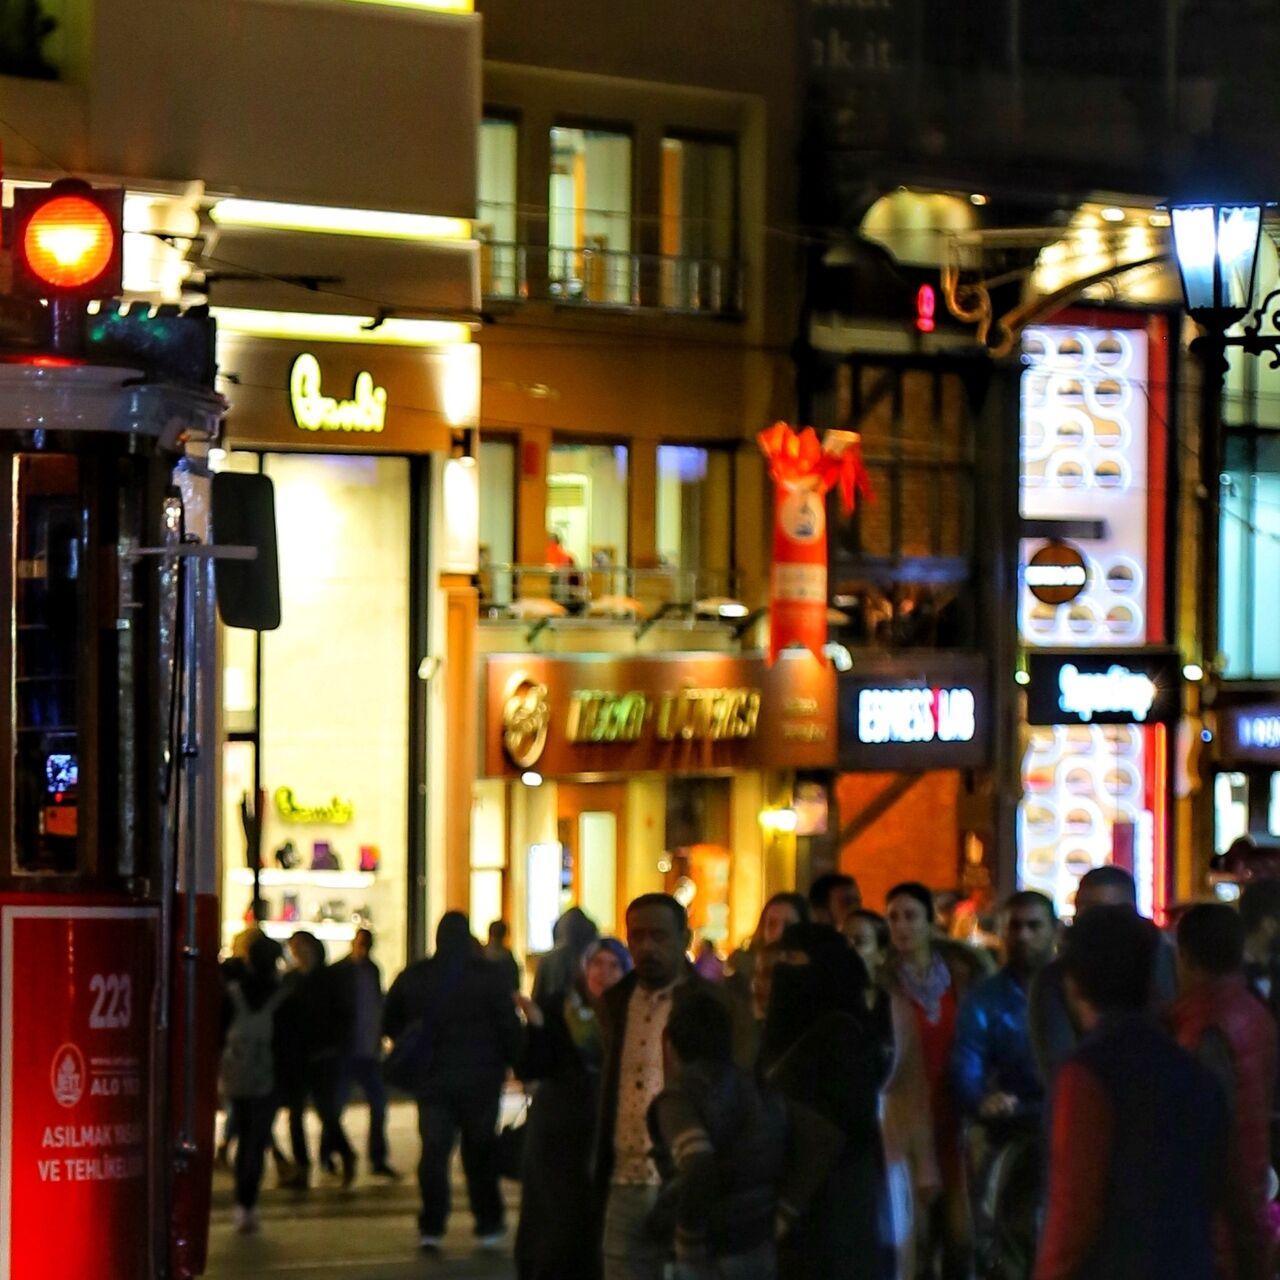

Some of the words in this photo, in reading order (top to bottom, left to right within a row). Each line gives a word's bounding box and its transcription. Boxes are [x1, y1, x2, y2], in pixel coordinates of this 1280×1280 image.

[88, 973, 133, 1030] 223
[90, 1077, 120, 1096] ALO
[41, 1124, 112, 1149] ASILMAK
[37, 1158, 61, 1182] VE
